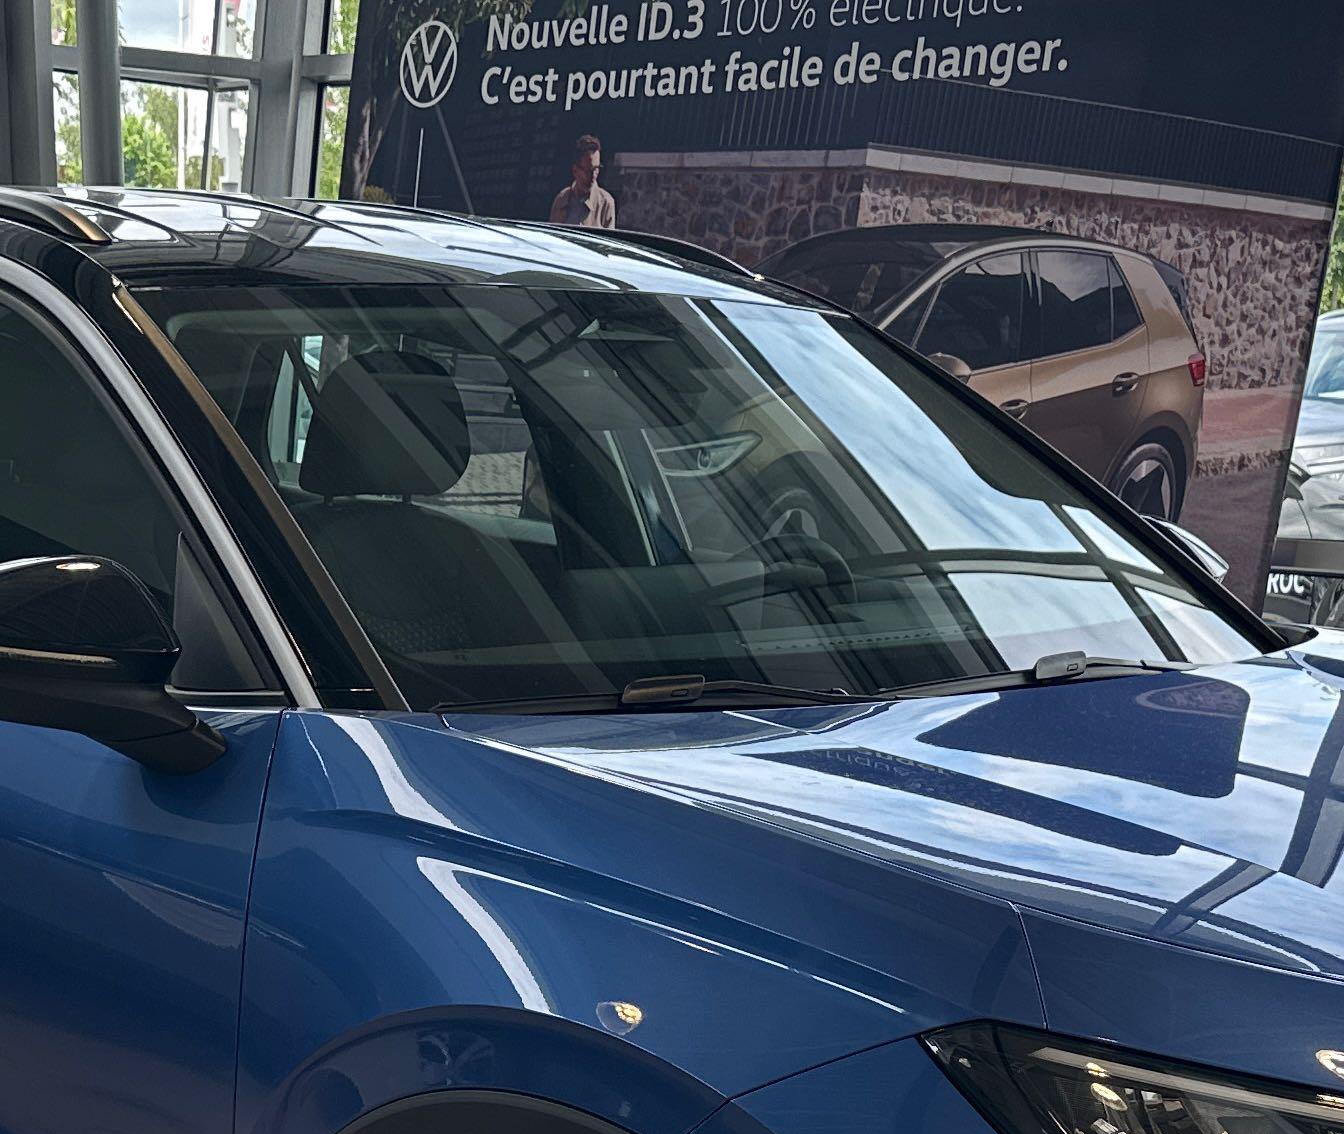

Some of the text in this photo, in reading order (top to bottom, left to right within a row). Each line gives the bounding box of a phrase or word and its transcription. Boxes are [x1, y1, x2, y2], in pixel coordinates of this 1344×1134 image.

[486, 4, 628, 51] Nouvelle
[637, 0, 705, 41] ID.3
[716, 0, 816, 36] 100%
[481, 36, 1068, 110] C'est pourtant facile de changer.
